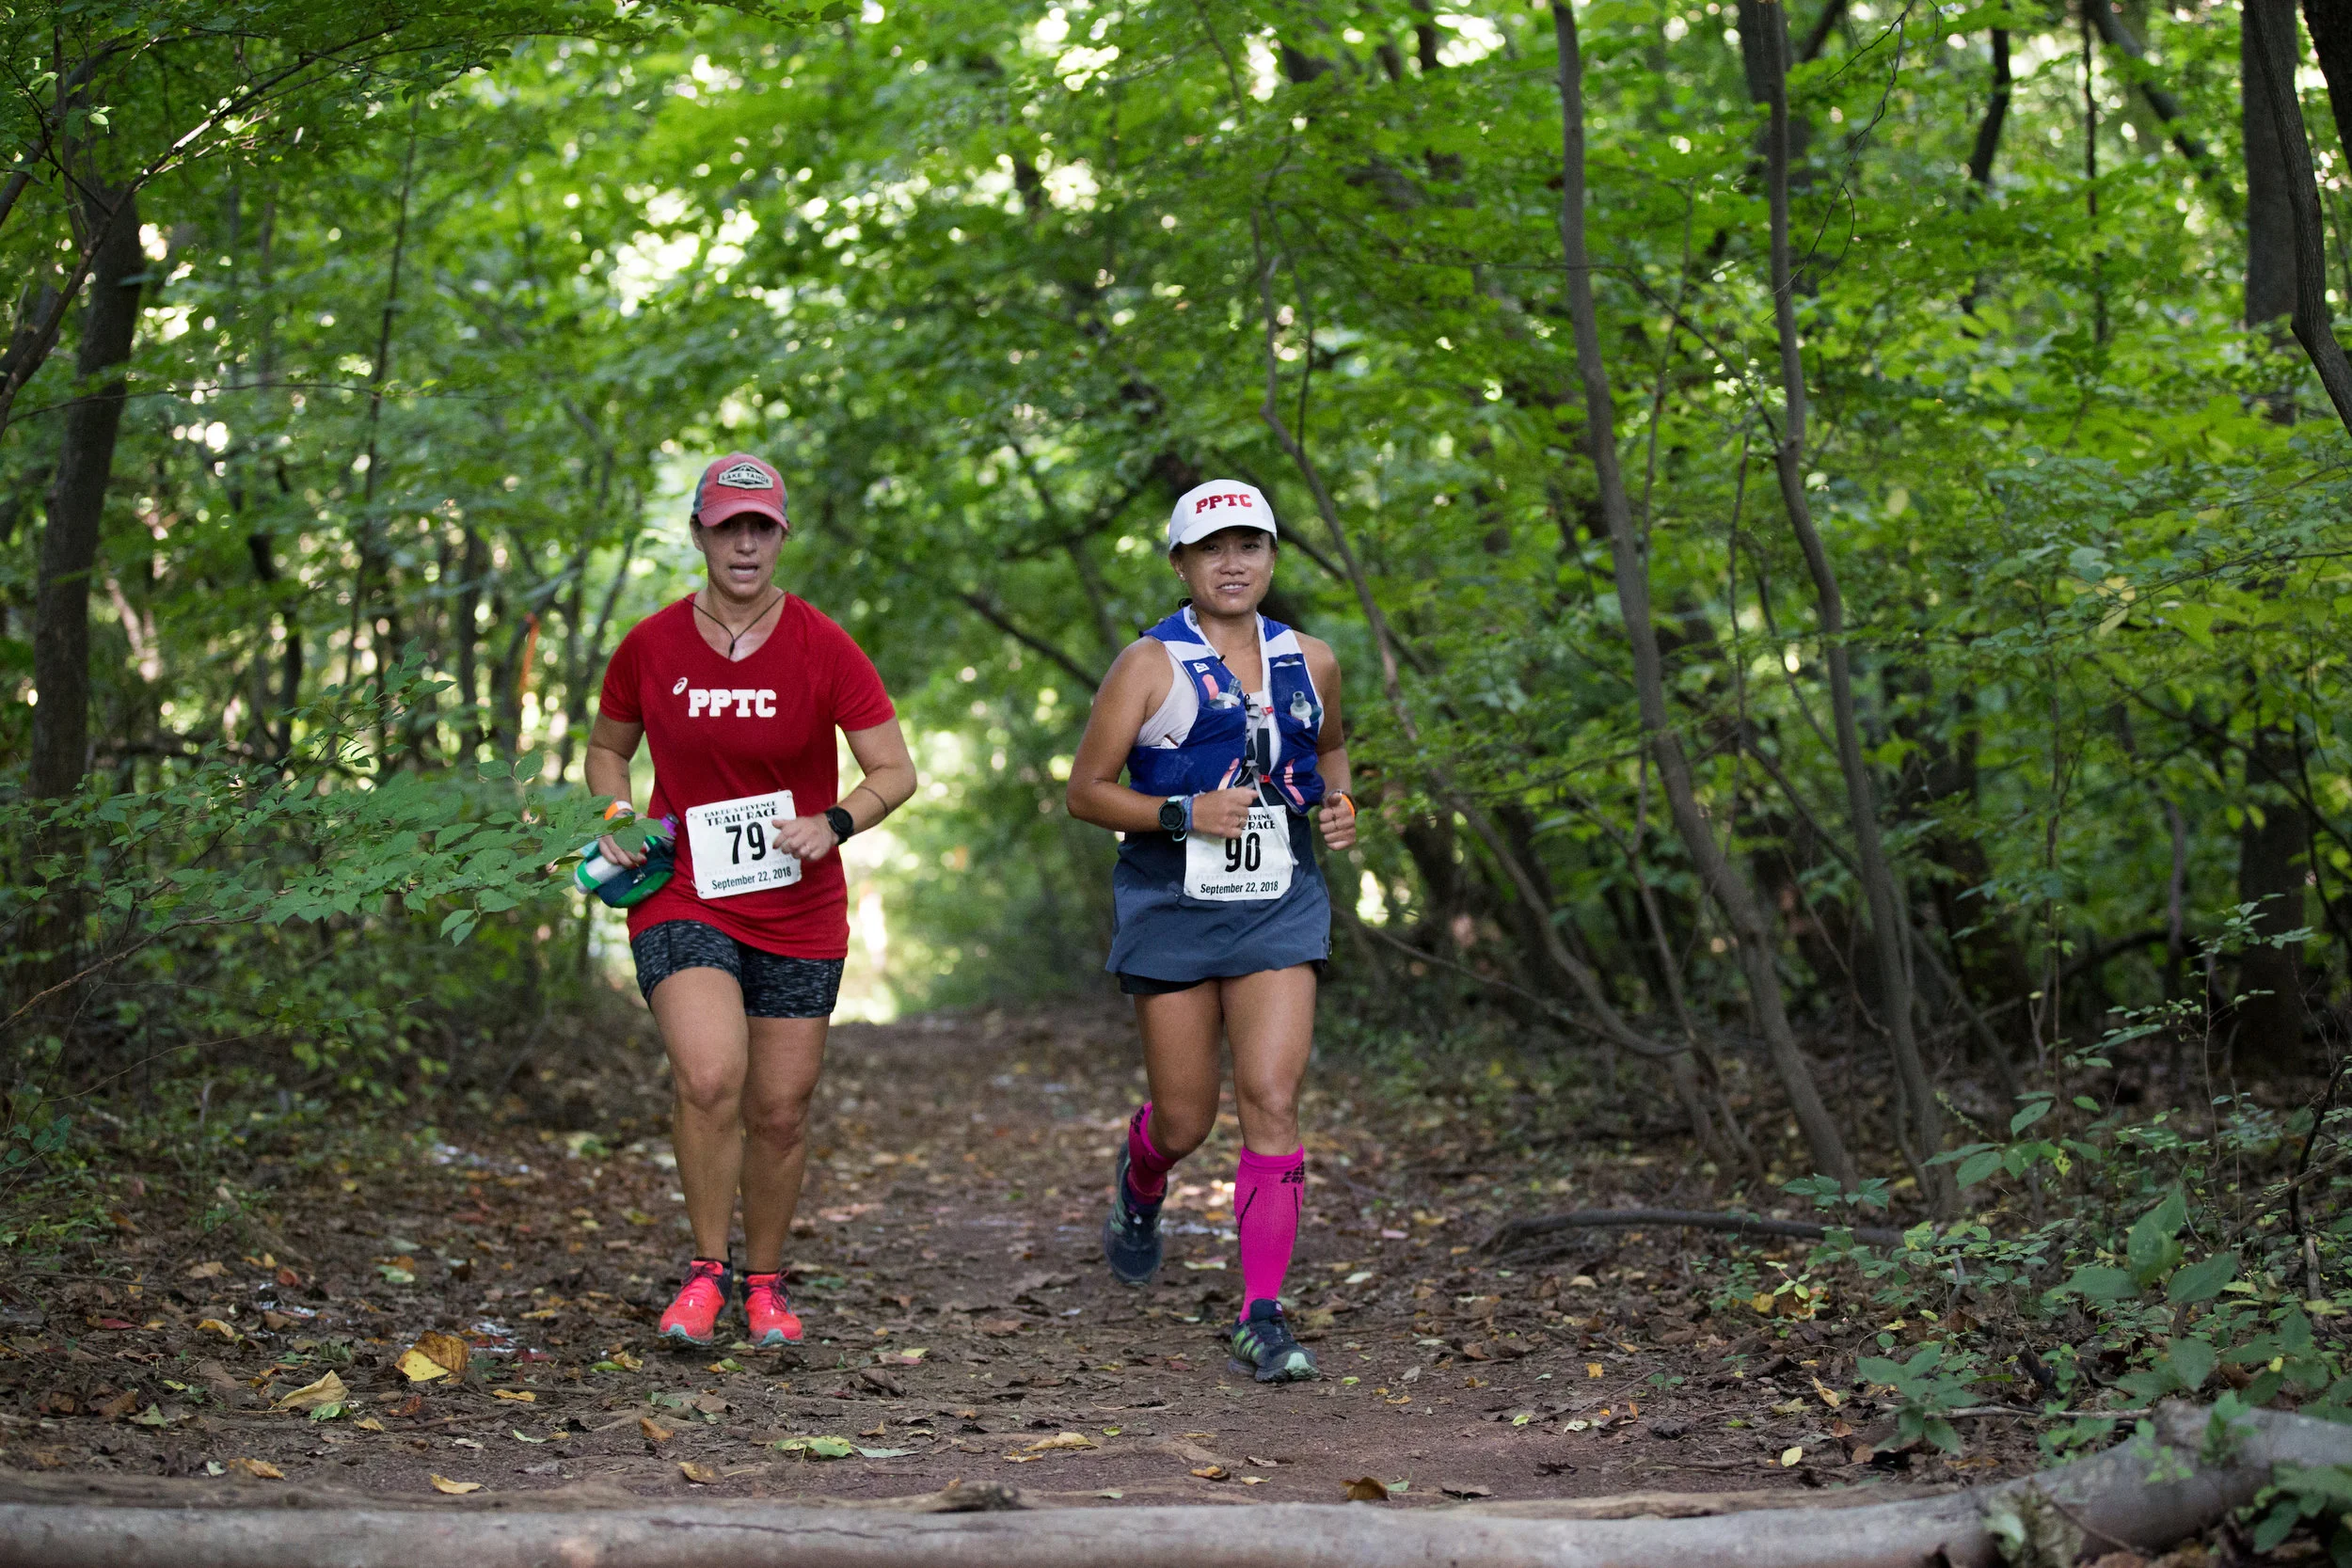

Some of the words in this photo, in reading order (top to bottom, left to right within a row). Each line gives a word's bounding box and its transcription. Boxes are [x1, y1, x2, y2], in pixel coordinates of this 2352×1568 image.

[747, 473, 769, 483] TAHOE
[1196, 494, 1252, 515] PPTC
[688, 689, 777, 718] PPTC
[707, 814, 743, 826] TRAIL
[747, 807, 779, 819] RACE
[1248, 820, 1276, 830] RACE
[725, 822, 766, 864] 79
[1225, 832, 1260, 872] 90
[712, 875, 755, 890] September
[758, 871, 771, 882] 22,
[773, 866, 791, 879] 2018
[1200, 883, 1243, 895] September
[1246, 882, 1258, 894] 22,
[1261, 880, 1278, 892] 2018
